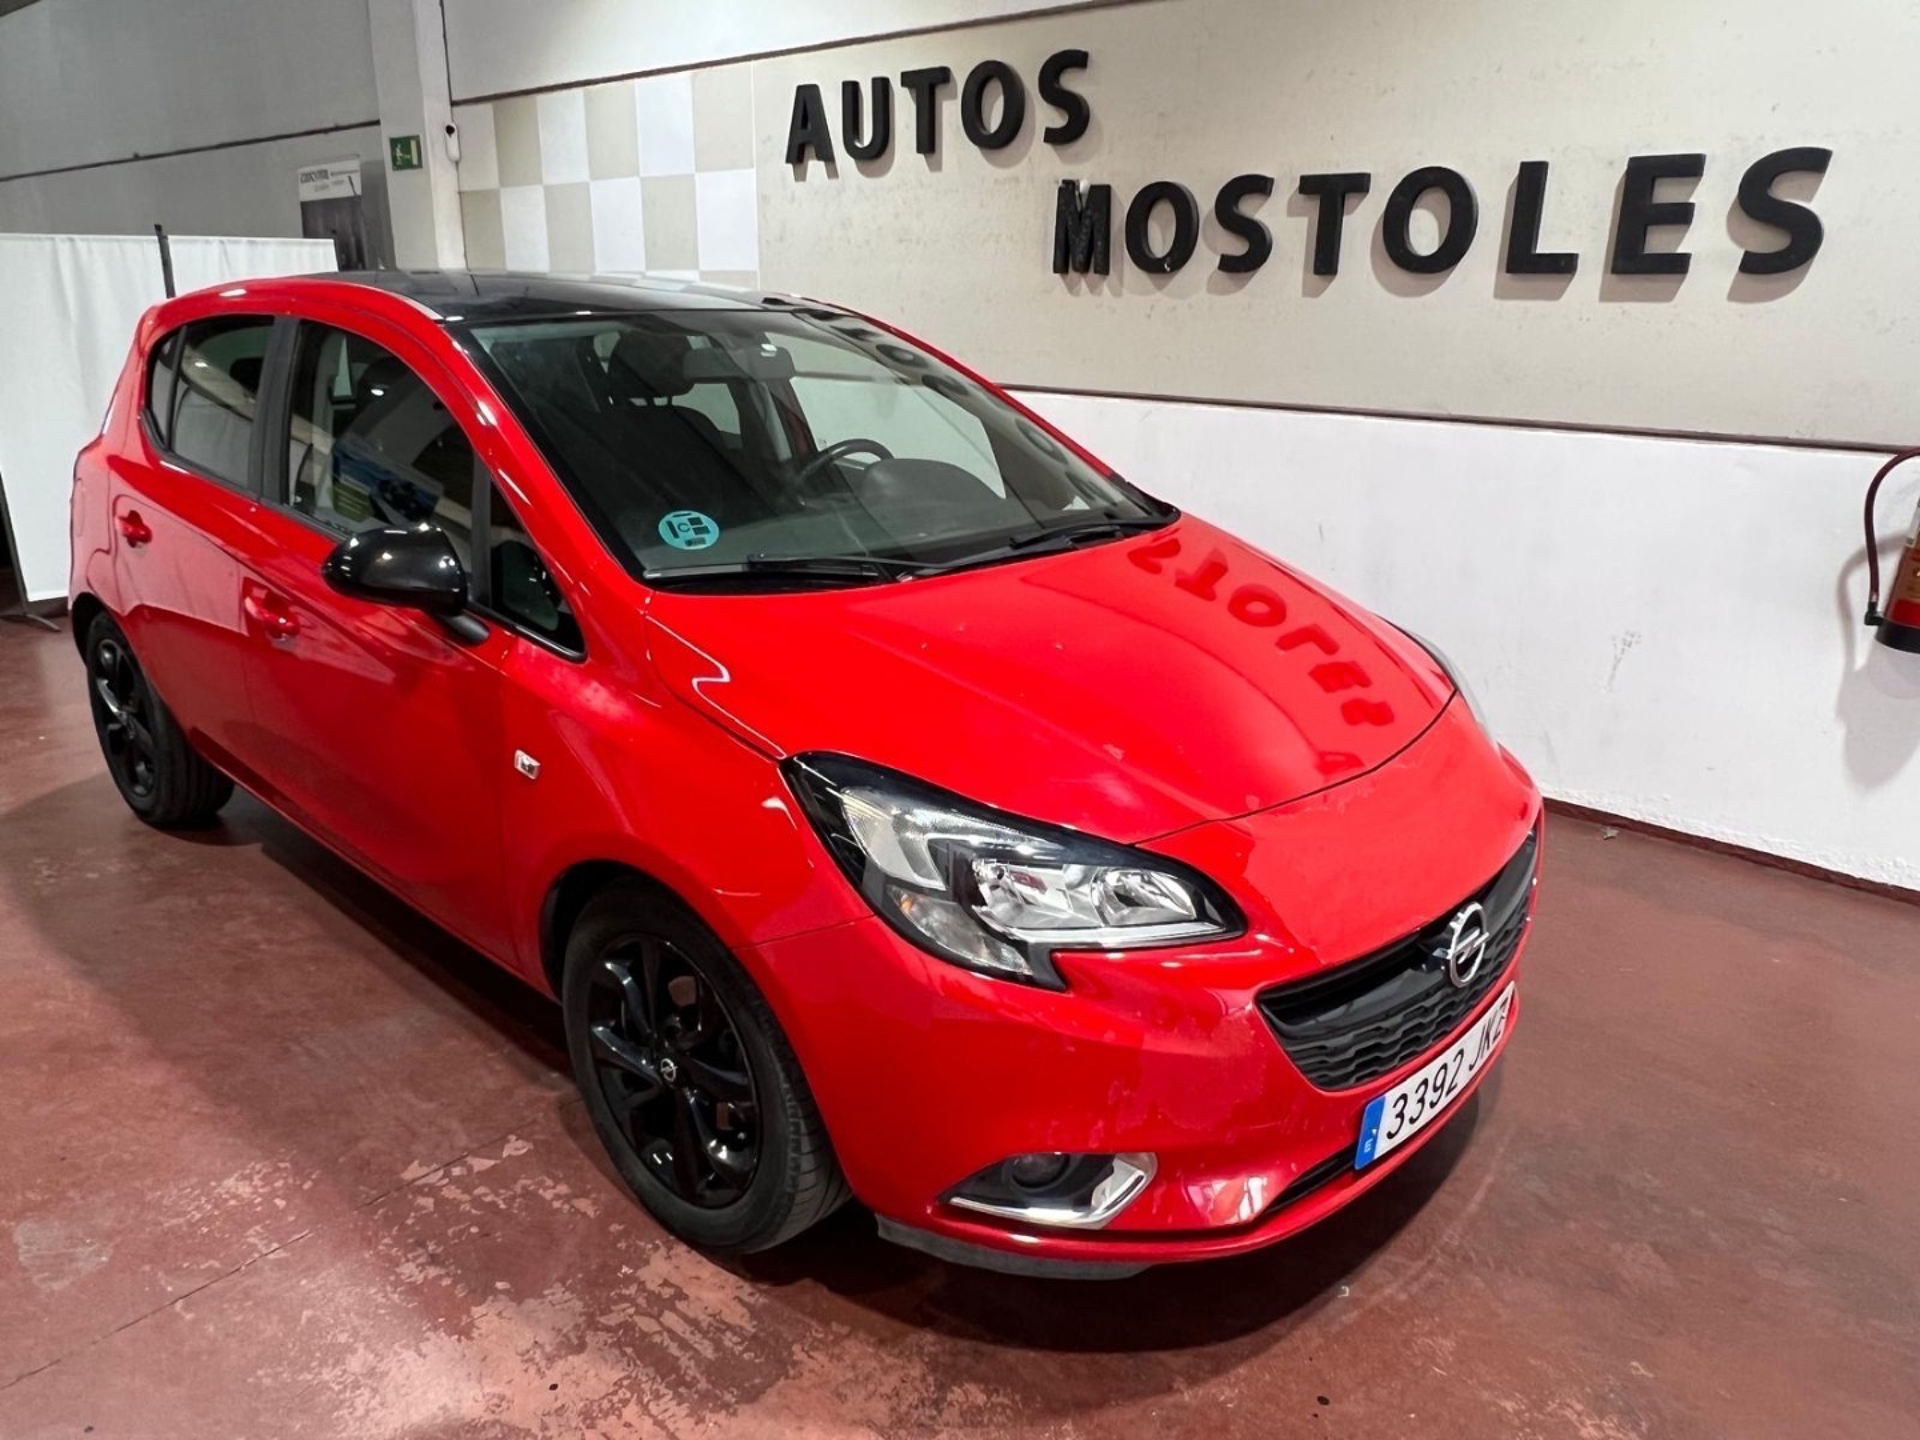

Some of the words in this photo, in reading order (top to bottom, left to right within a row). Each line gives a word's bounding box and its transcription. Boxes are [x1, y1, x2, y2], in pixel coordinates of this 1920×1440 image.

[786, 49, 1091, 165] AUTOS
[1053, 147, 1832, 276] MOSTOLES
[1386, 1048, 1465, 1140] 3392
